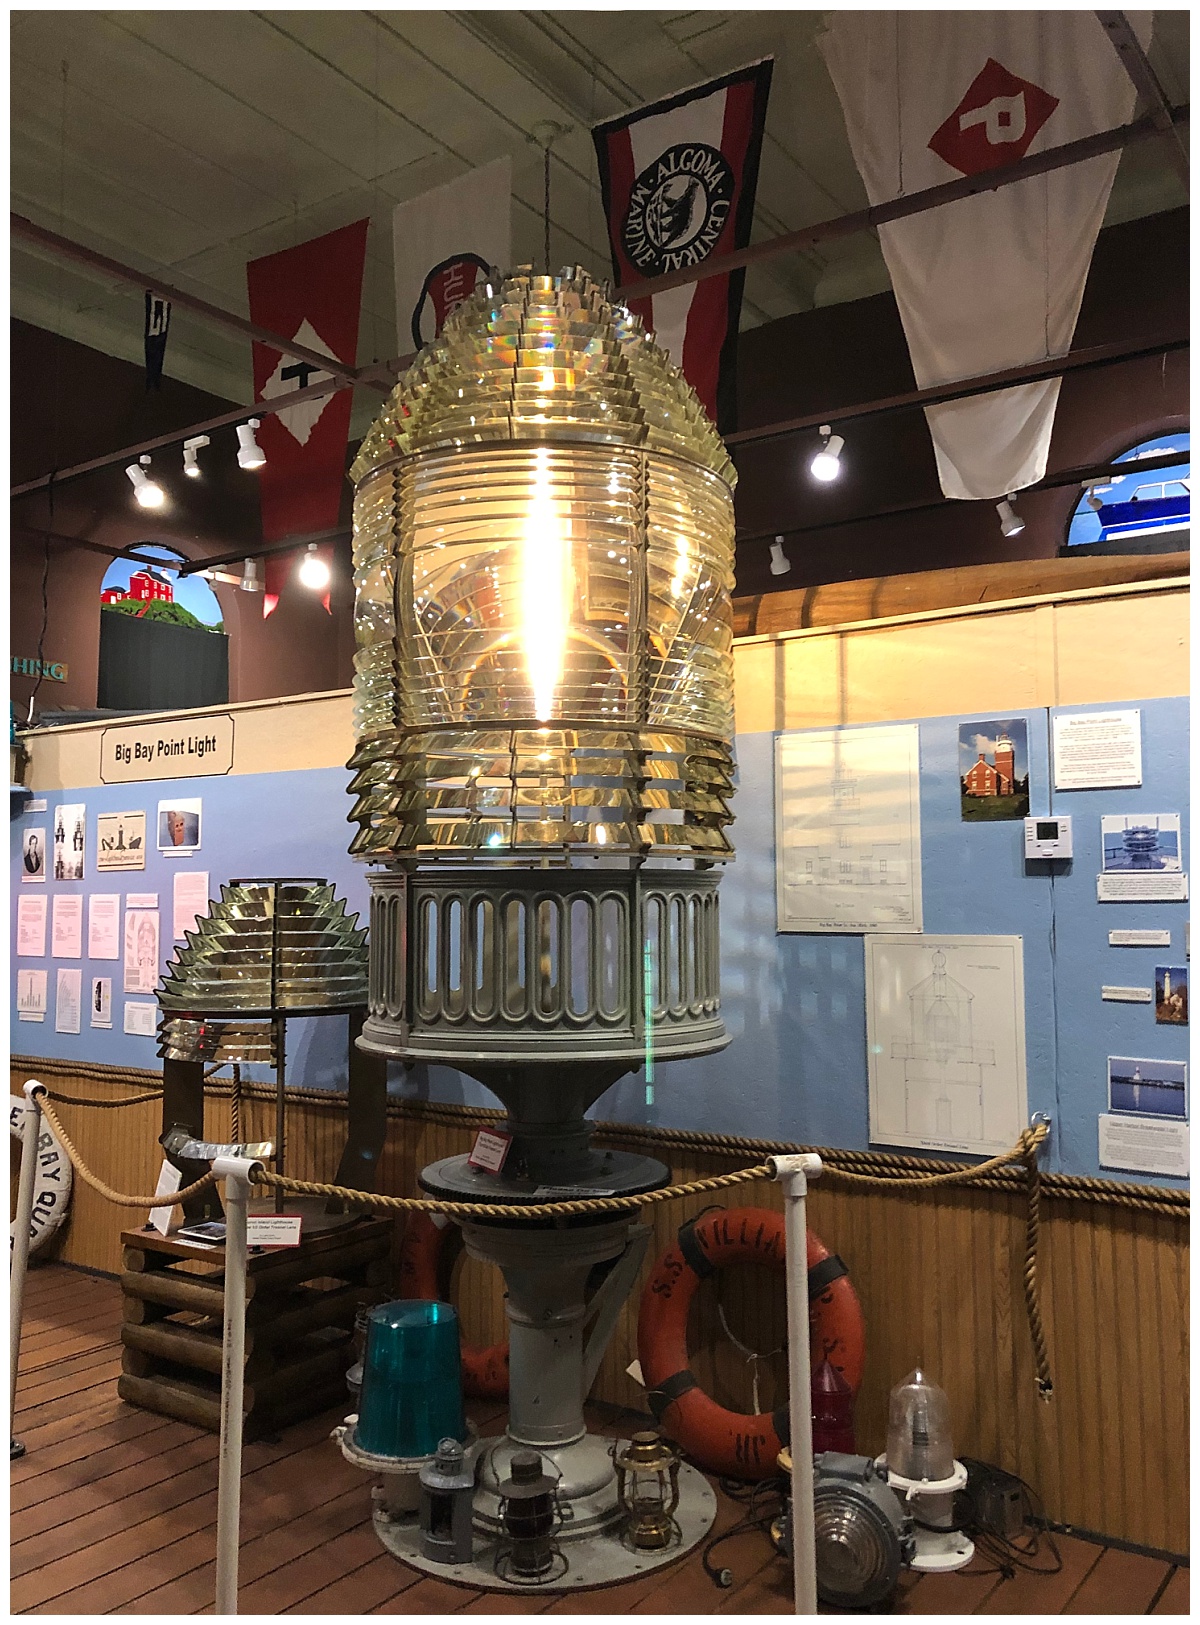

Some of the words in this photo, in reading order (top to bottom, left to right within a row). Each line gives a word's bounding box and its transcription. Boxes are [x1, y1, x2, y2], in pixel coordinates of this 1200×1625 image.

[657, 148, 726, 193] ALGOMA
[625, 183, 657, 267] MARINE
[660, 199, 730, 273] CENTRAL
[115, 744, 132, 764] Big
[134, 742, 154, 762] Bay
[157, 738, 185, 757] Point
[188, 735, 216, 757] Light
[38, 1132, 61, 1183] BAY
